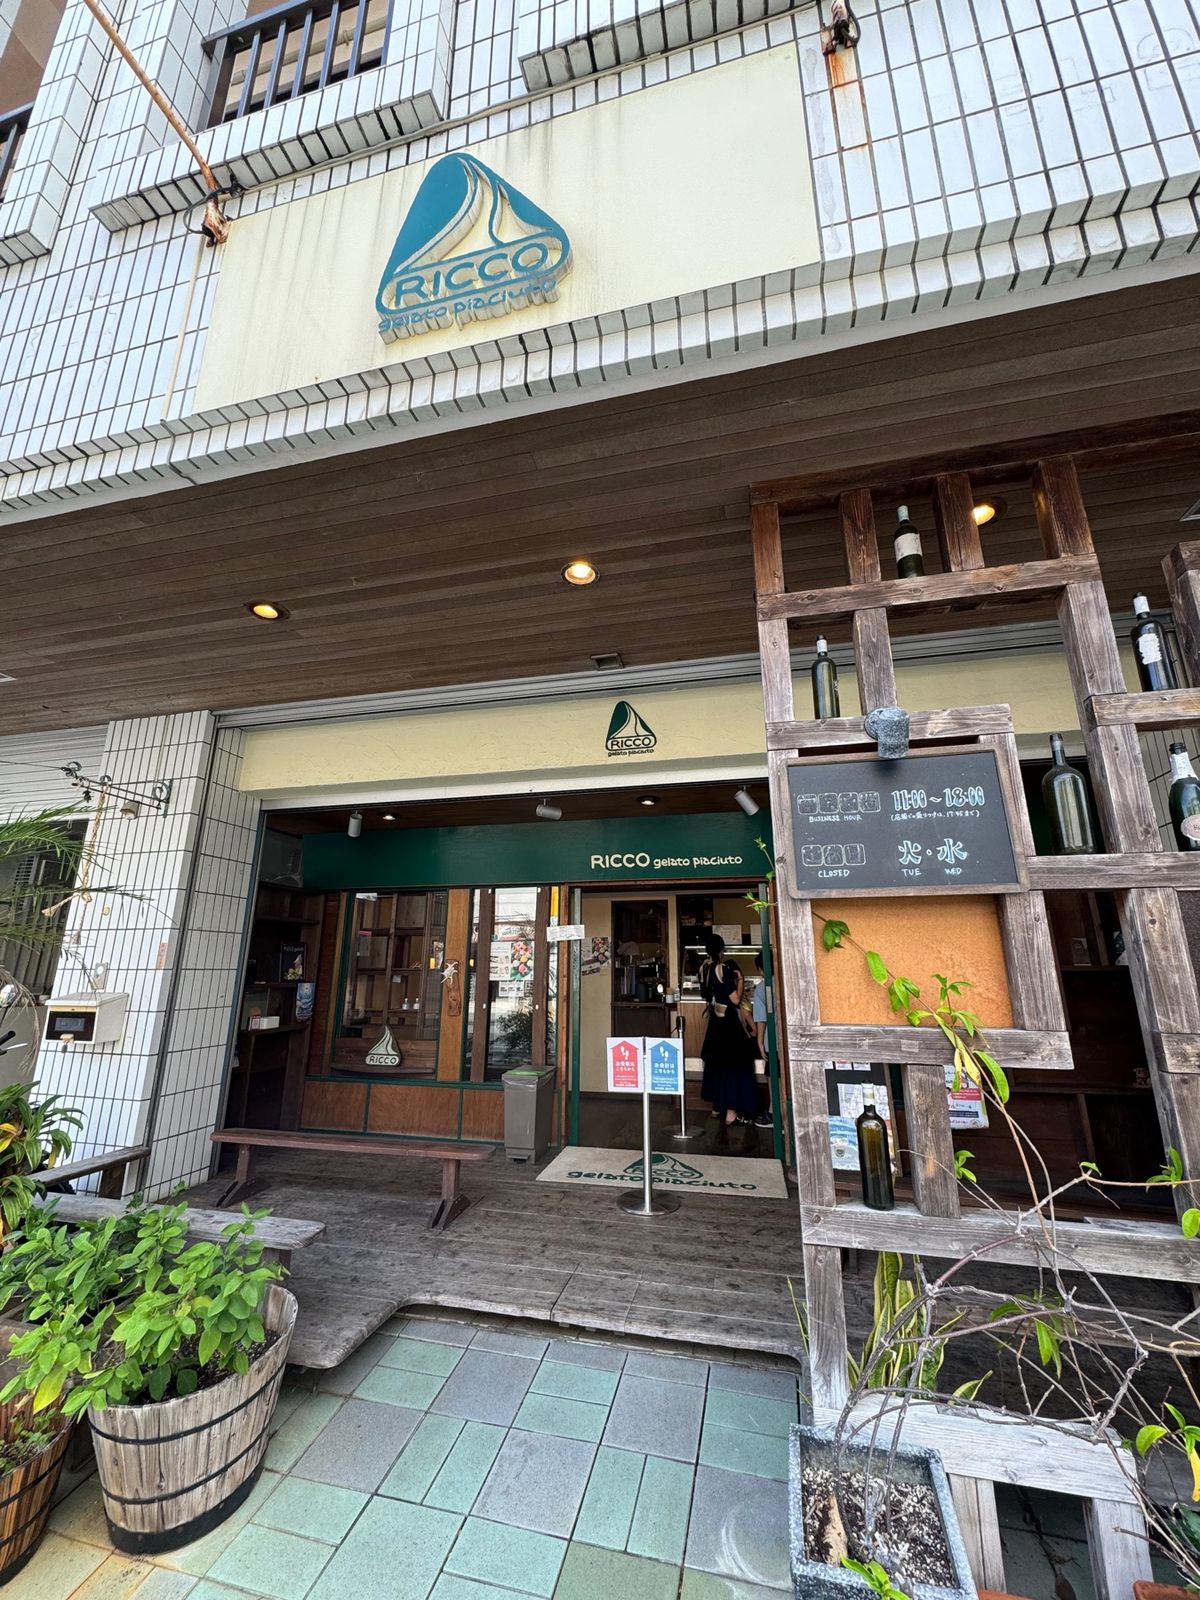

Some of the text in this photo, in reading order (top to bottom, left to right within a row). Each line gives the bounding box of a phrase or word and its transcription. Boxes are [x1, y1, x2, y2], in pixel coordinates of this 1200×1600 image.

[394, 242, 549, 309] RICCO
[378, 279, 558, 333] gelato piaciuto
[610, 737, 652, 750] RICCO
[808, 815, 841, 823] BUSINESS
[590, 852, 743, 870] RICCO gelato piaciuto
[817, 869, 850, 878] CLOSED
[901, 868, 922, 877] TUE
[944, 867, 963, 876] WED
[368, 1055, 398, 1065] RICCO
[631, 1167, 695, 1178] RCCO
[566, 1170, 757, 1190] gelato piaciuto
